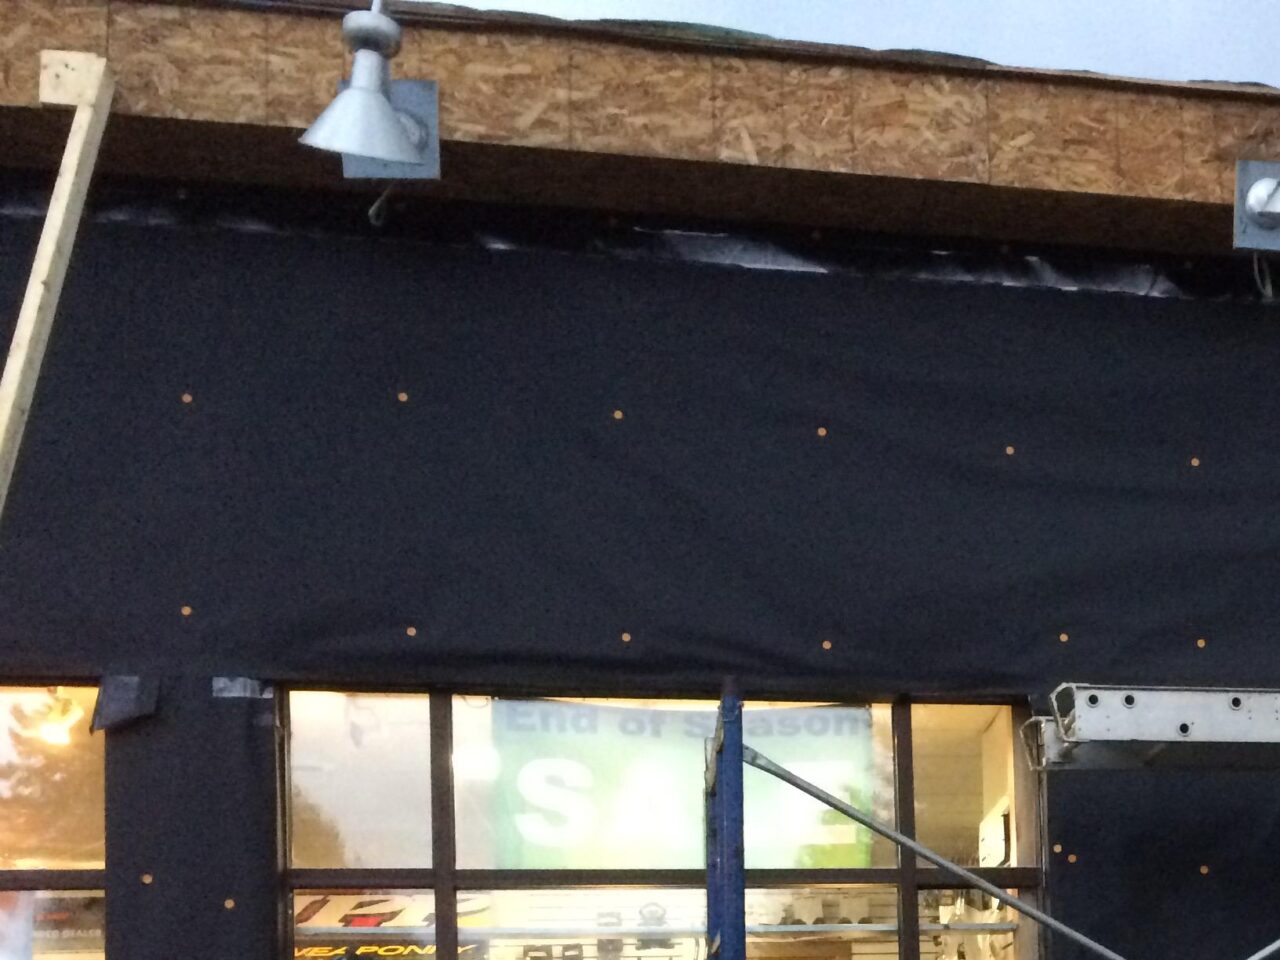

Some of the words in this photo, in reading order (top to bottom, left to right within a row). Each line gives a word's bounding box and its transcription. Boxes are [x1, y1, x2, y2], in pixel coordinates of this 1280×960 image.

[505, 702, 598, 734] End
[618, 710, 667, 738] of
[683, 708, 863, 739] Sason
